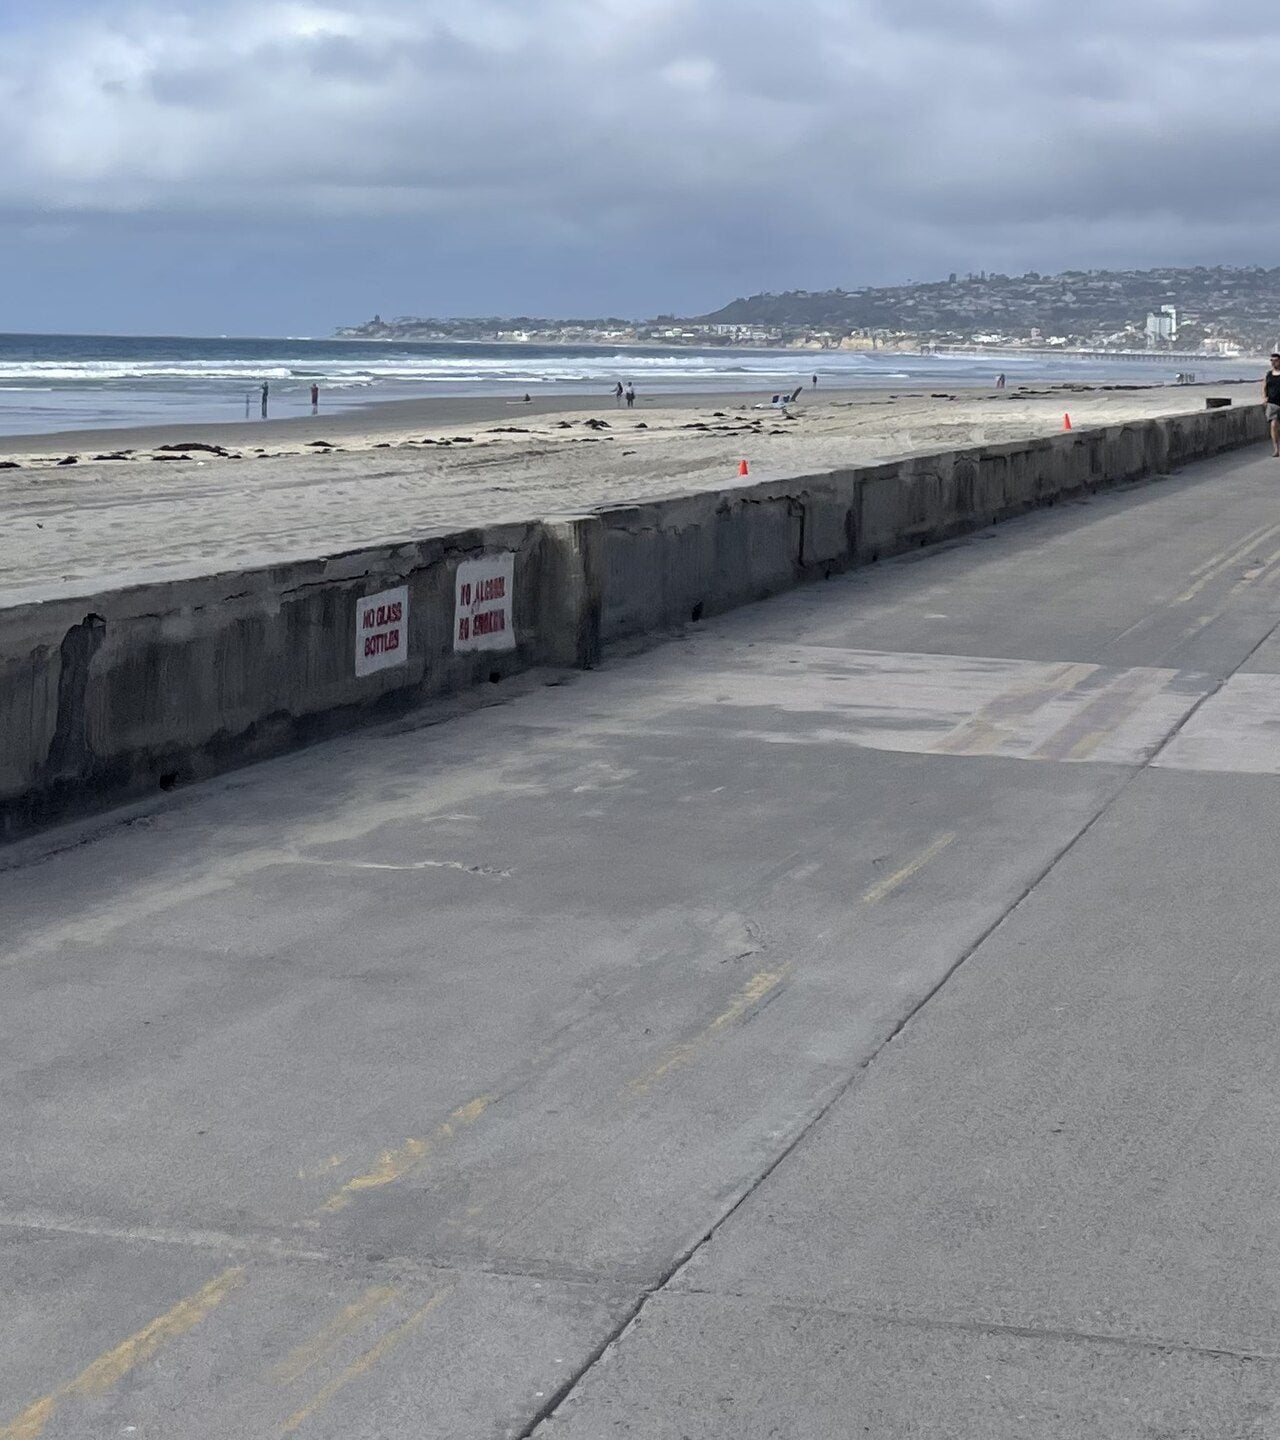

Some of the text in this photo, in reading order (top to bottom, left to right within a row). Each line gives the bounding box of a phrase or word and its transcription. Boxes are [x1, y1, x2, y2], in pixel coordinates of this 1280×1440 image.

[461, 583, 471, 606] NO
[363, 602, 402, 629] NO GLASS
[364, 629, 400, 657] BOTTLES
